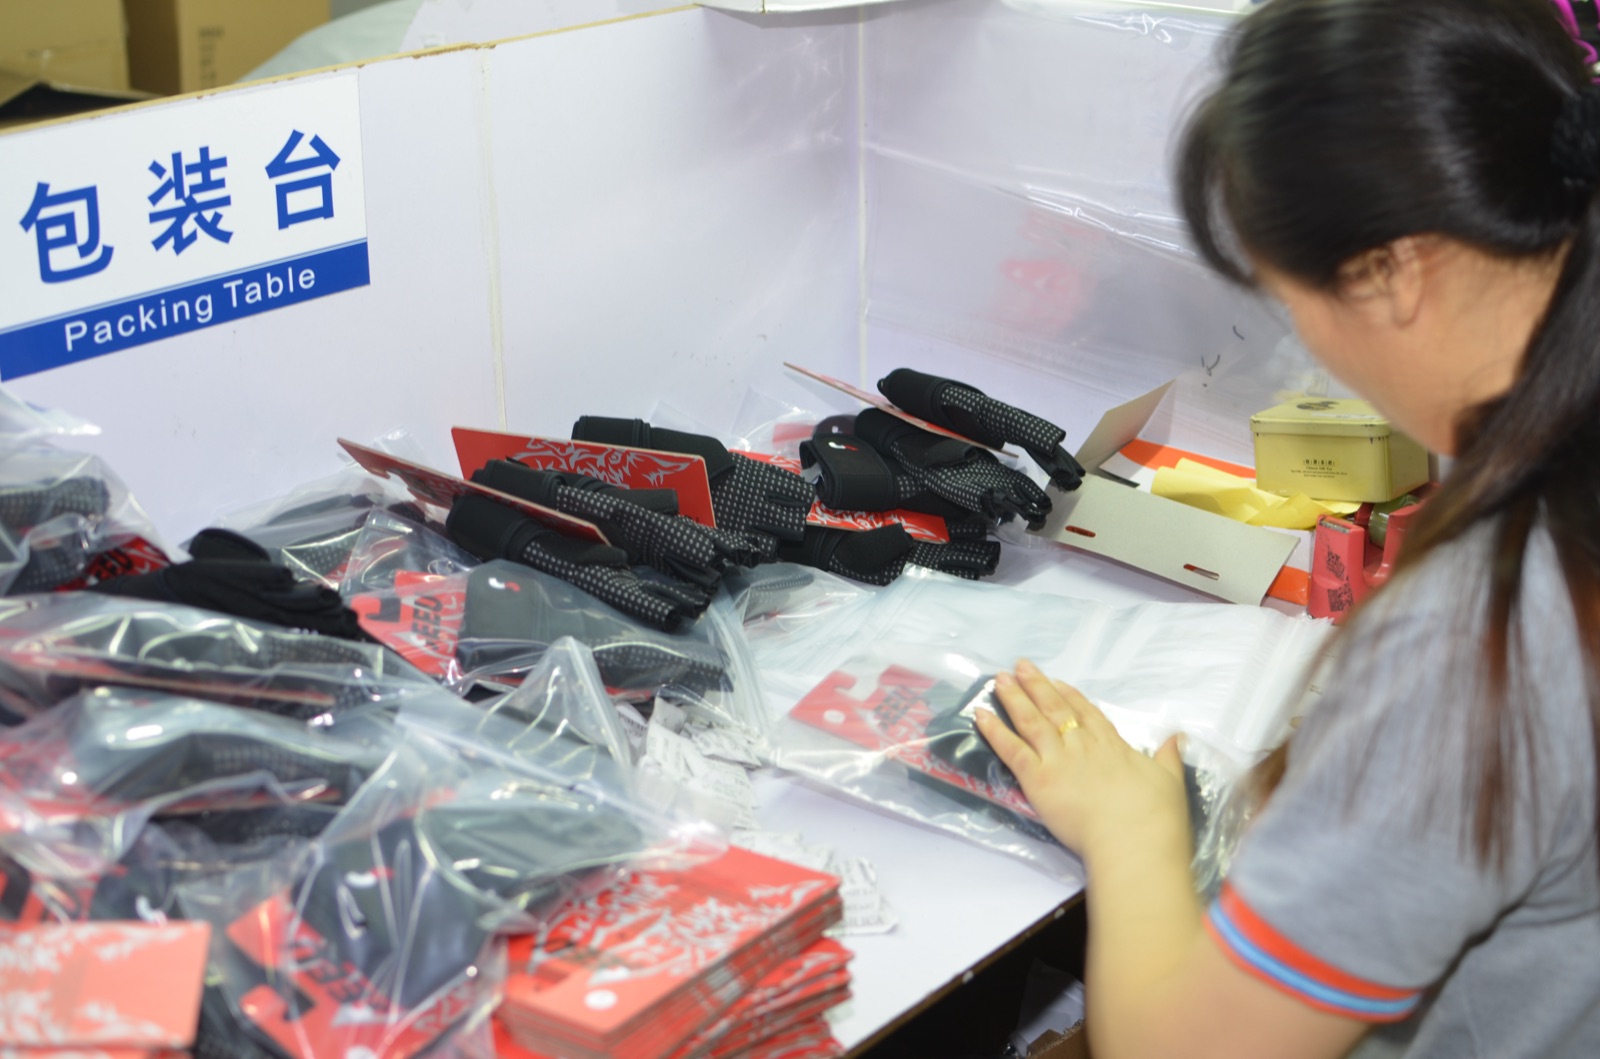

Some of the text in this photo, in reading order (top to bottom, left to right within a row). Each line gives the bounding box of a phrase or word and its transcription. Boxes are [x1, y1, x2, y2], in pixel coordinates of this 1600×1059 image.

[19, 128, 341, 284] 包装台
[64, 266, 316, 352] Packing Table
